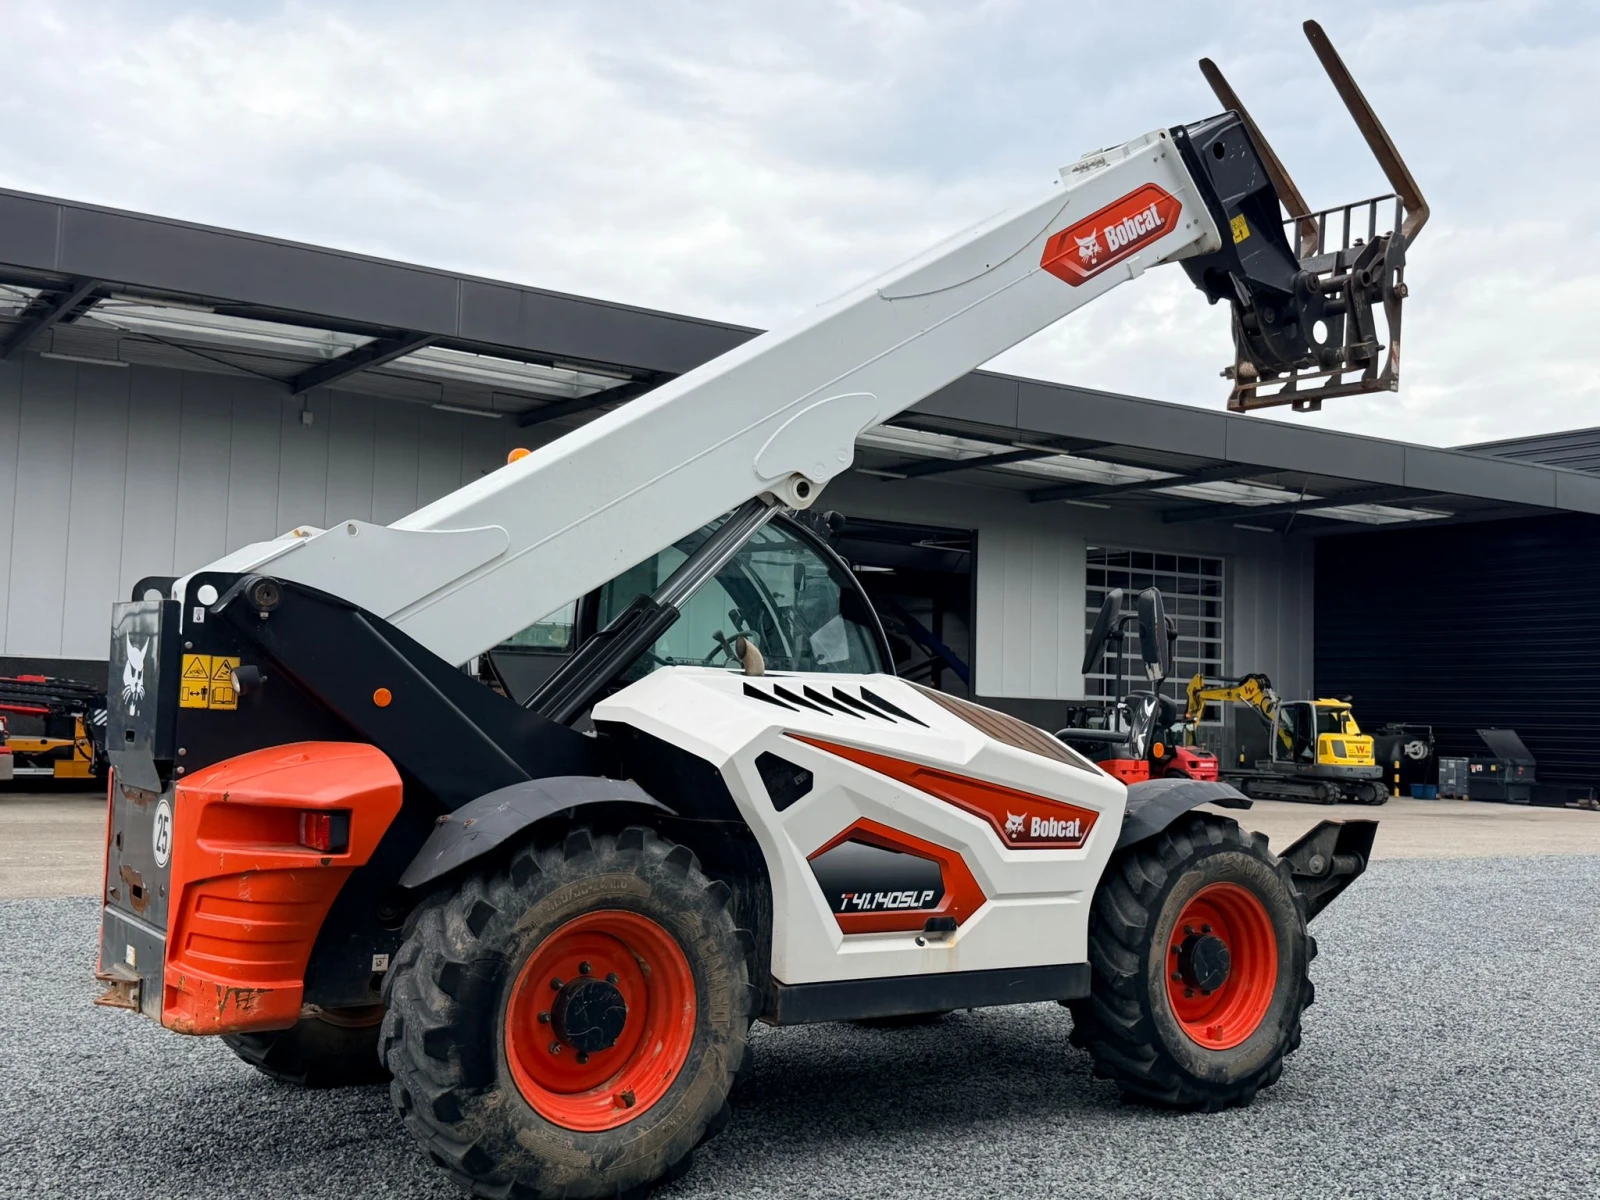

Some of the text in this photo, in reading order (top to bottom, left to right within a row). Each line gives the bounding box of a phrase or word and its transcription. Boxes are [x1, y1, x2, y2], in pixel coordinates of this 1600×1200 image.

[1103, 203, 1162, 252] Bobcat
[156, 813, 169, 855] 25
[1030, 816, 1081, 838] Bobcat
